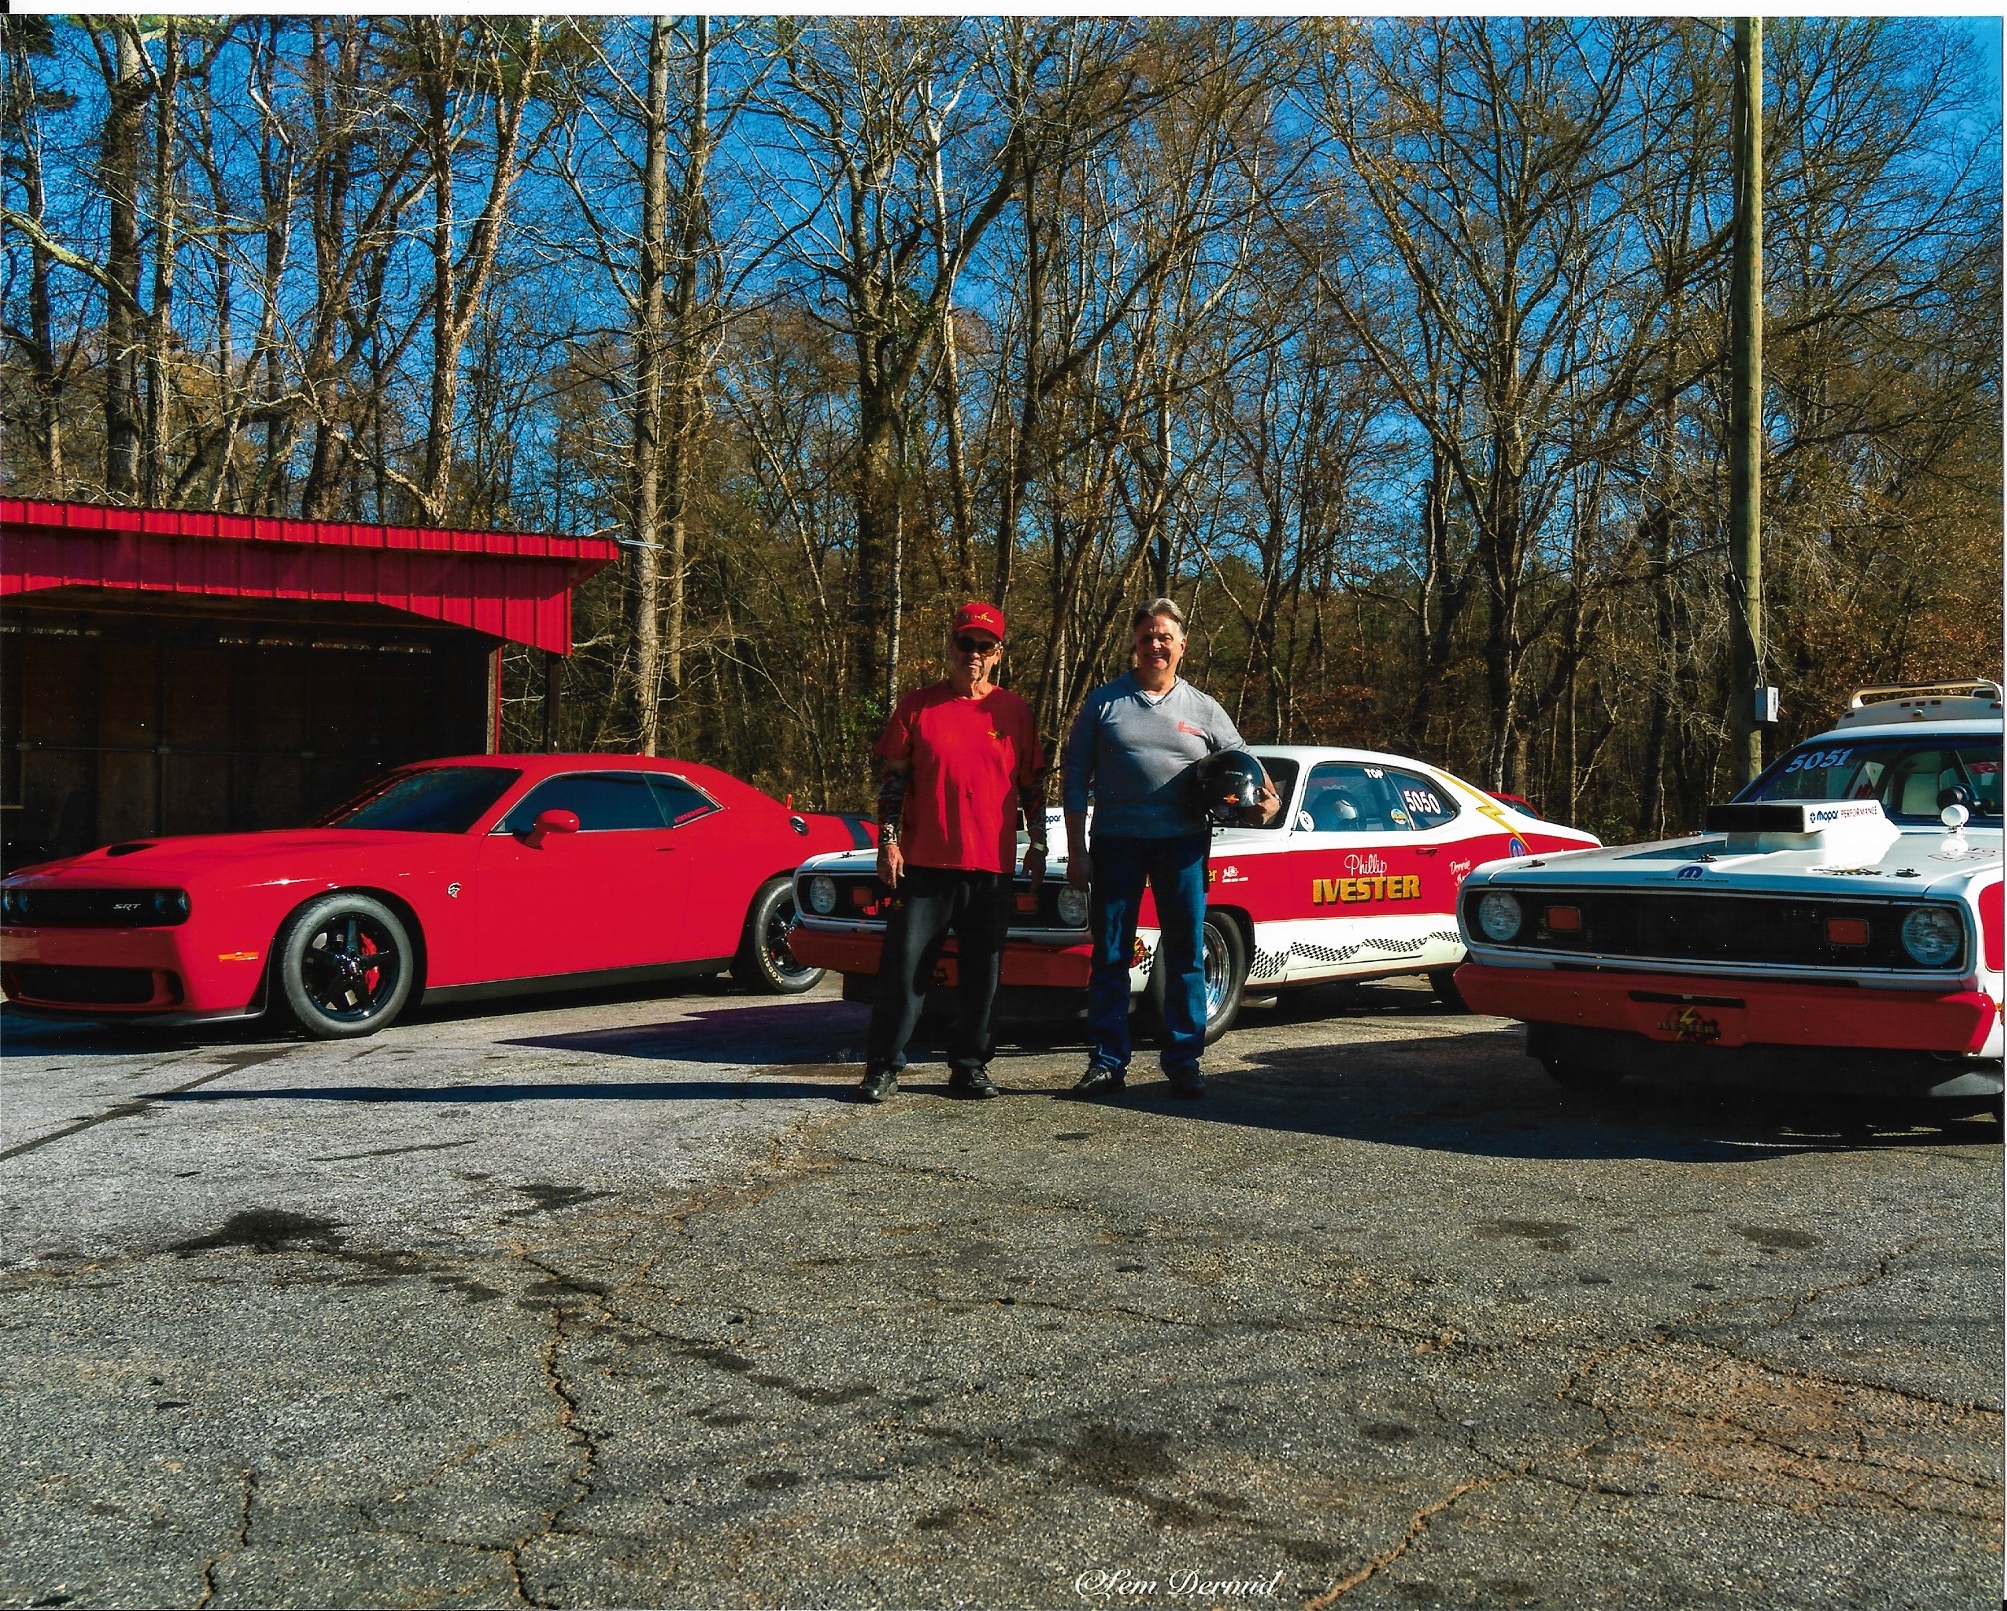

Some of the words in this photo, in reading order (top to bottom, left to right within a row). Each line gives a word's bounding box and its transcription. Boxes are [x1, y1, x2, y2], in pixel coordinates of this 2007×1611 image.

[1784, 748, 1854, 773] 5051
[1363, 767, 1384, 779] TOP
[1402, 789, 1441, 815] 5050
[1044, 814, 1062, 825] opar
[1344, 853, 1388, 877] Phillip
[1312, 874, 1422, 905] IVESTER
[112, 903, 142, 911] SRT
